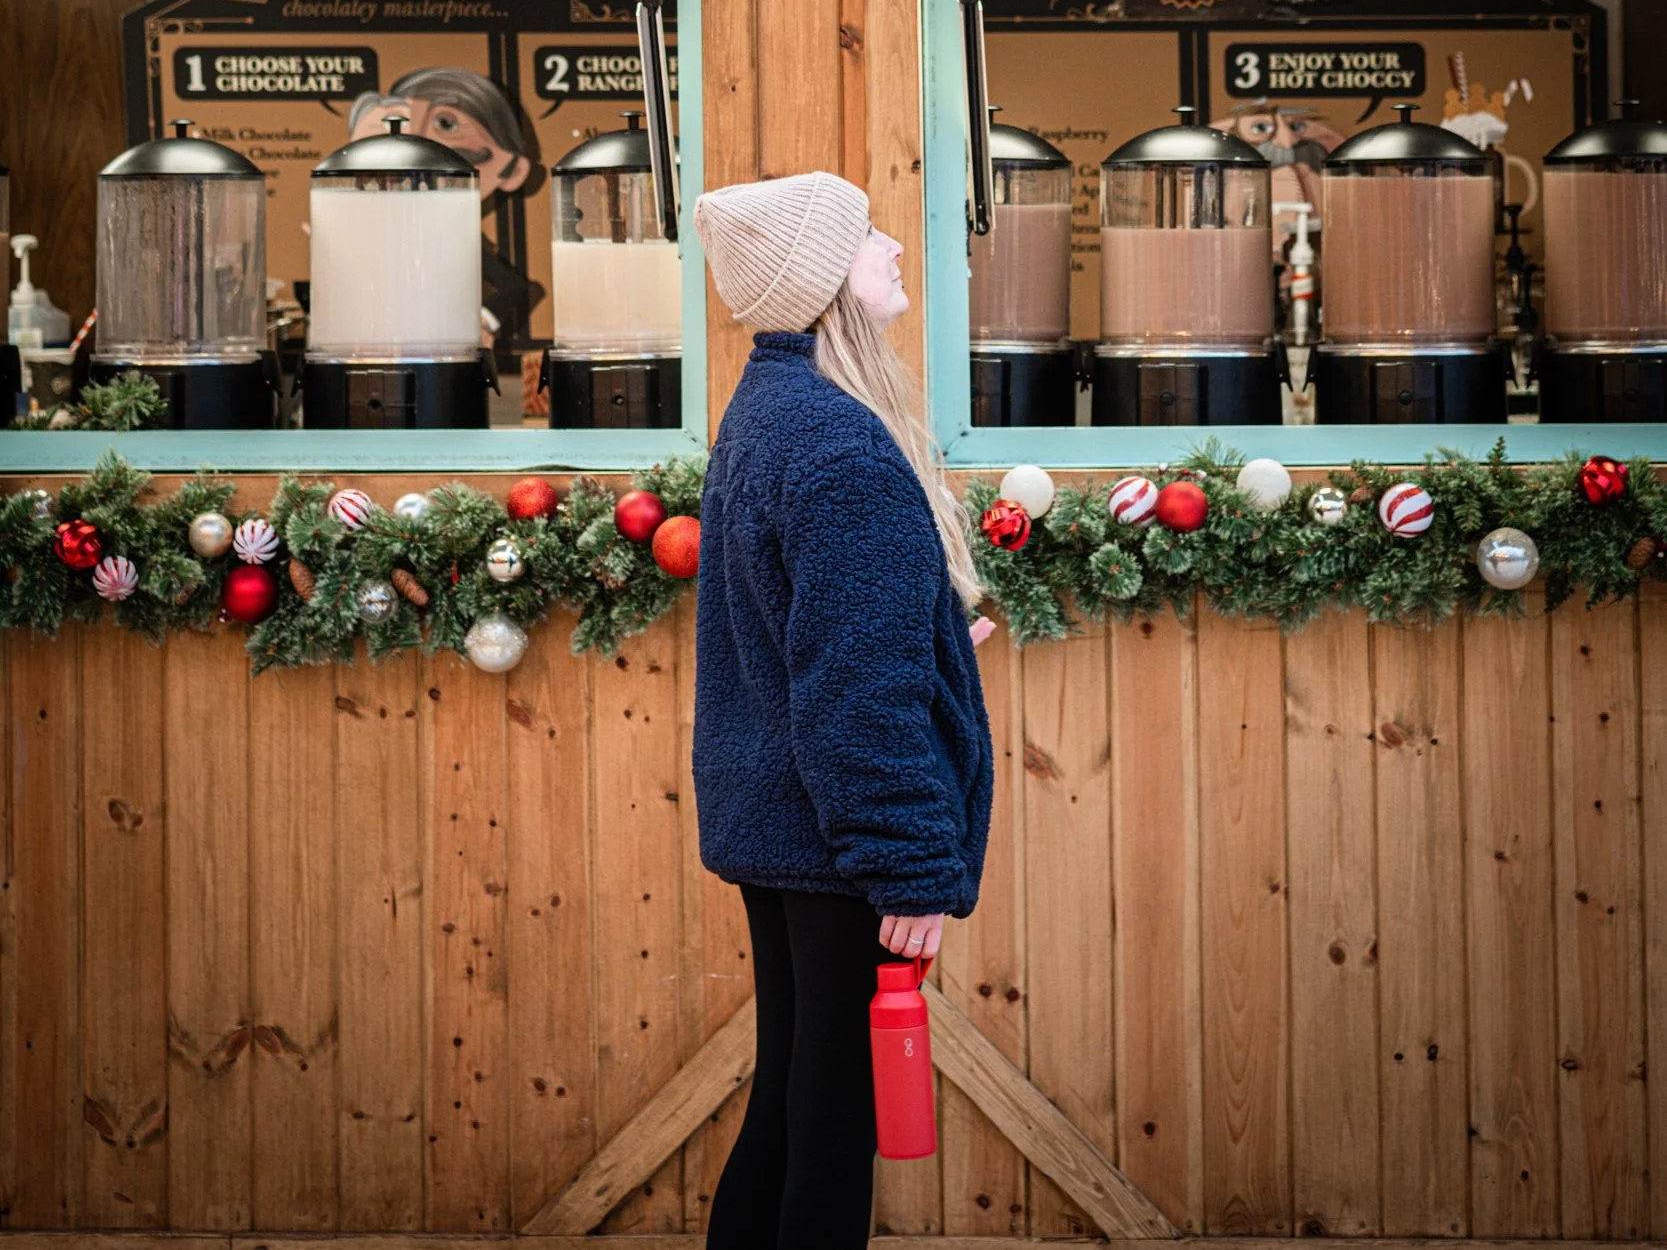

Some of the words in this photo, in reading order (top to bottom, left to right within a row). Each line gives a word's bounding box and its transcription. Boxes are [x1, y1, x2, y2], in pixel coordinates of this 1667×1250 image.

[214, 55, 302, 74] CHOOSE
[304, 55, 365, 74] YOUR
[576, 56, 642, 73] CHOO
[1234, 51, 1261, 89] 3
[1268, 52, 1336, 72] ENJOY
[1339, 52, 1400, 70] YOUR
[185, 54, 206, 91] 1
[544, 54, 570, 92] 2
[1268, 70, 1318, 88] HOT
[1320, 70, 1415, 88] CHOCCY
[215, 74, 344, 92] CHOCOLATE
[239, 126, 312, 142] Chocolate
[248, 145, 322, 161] Chocolate
